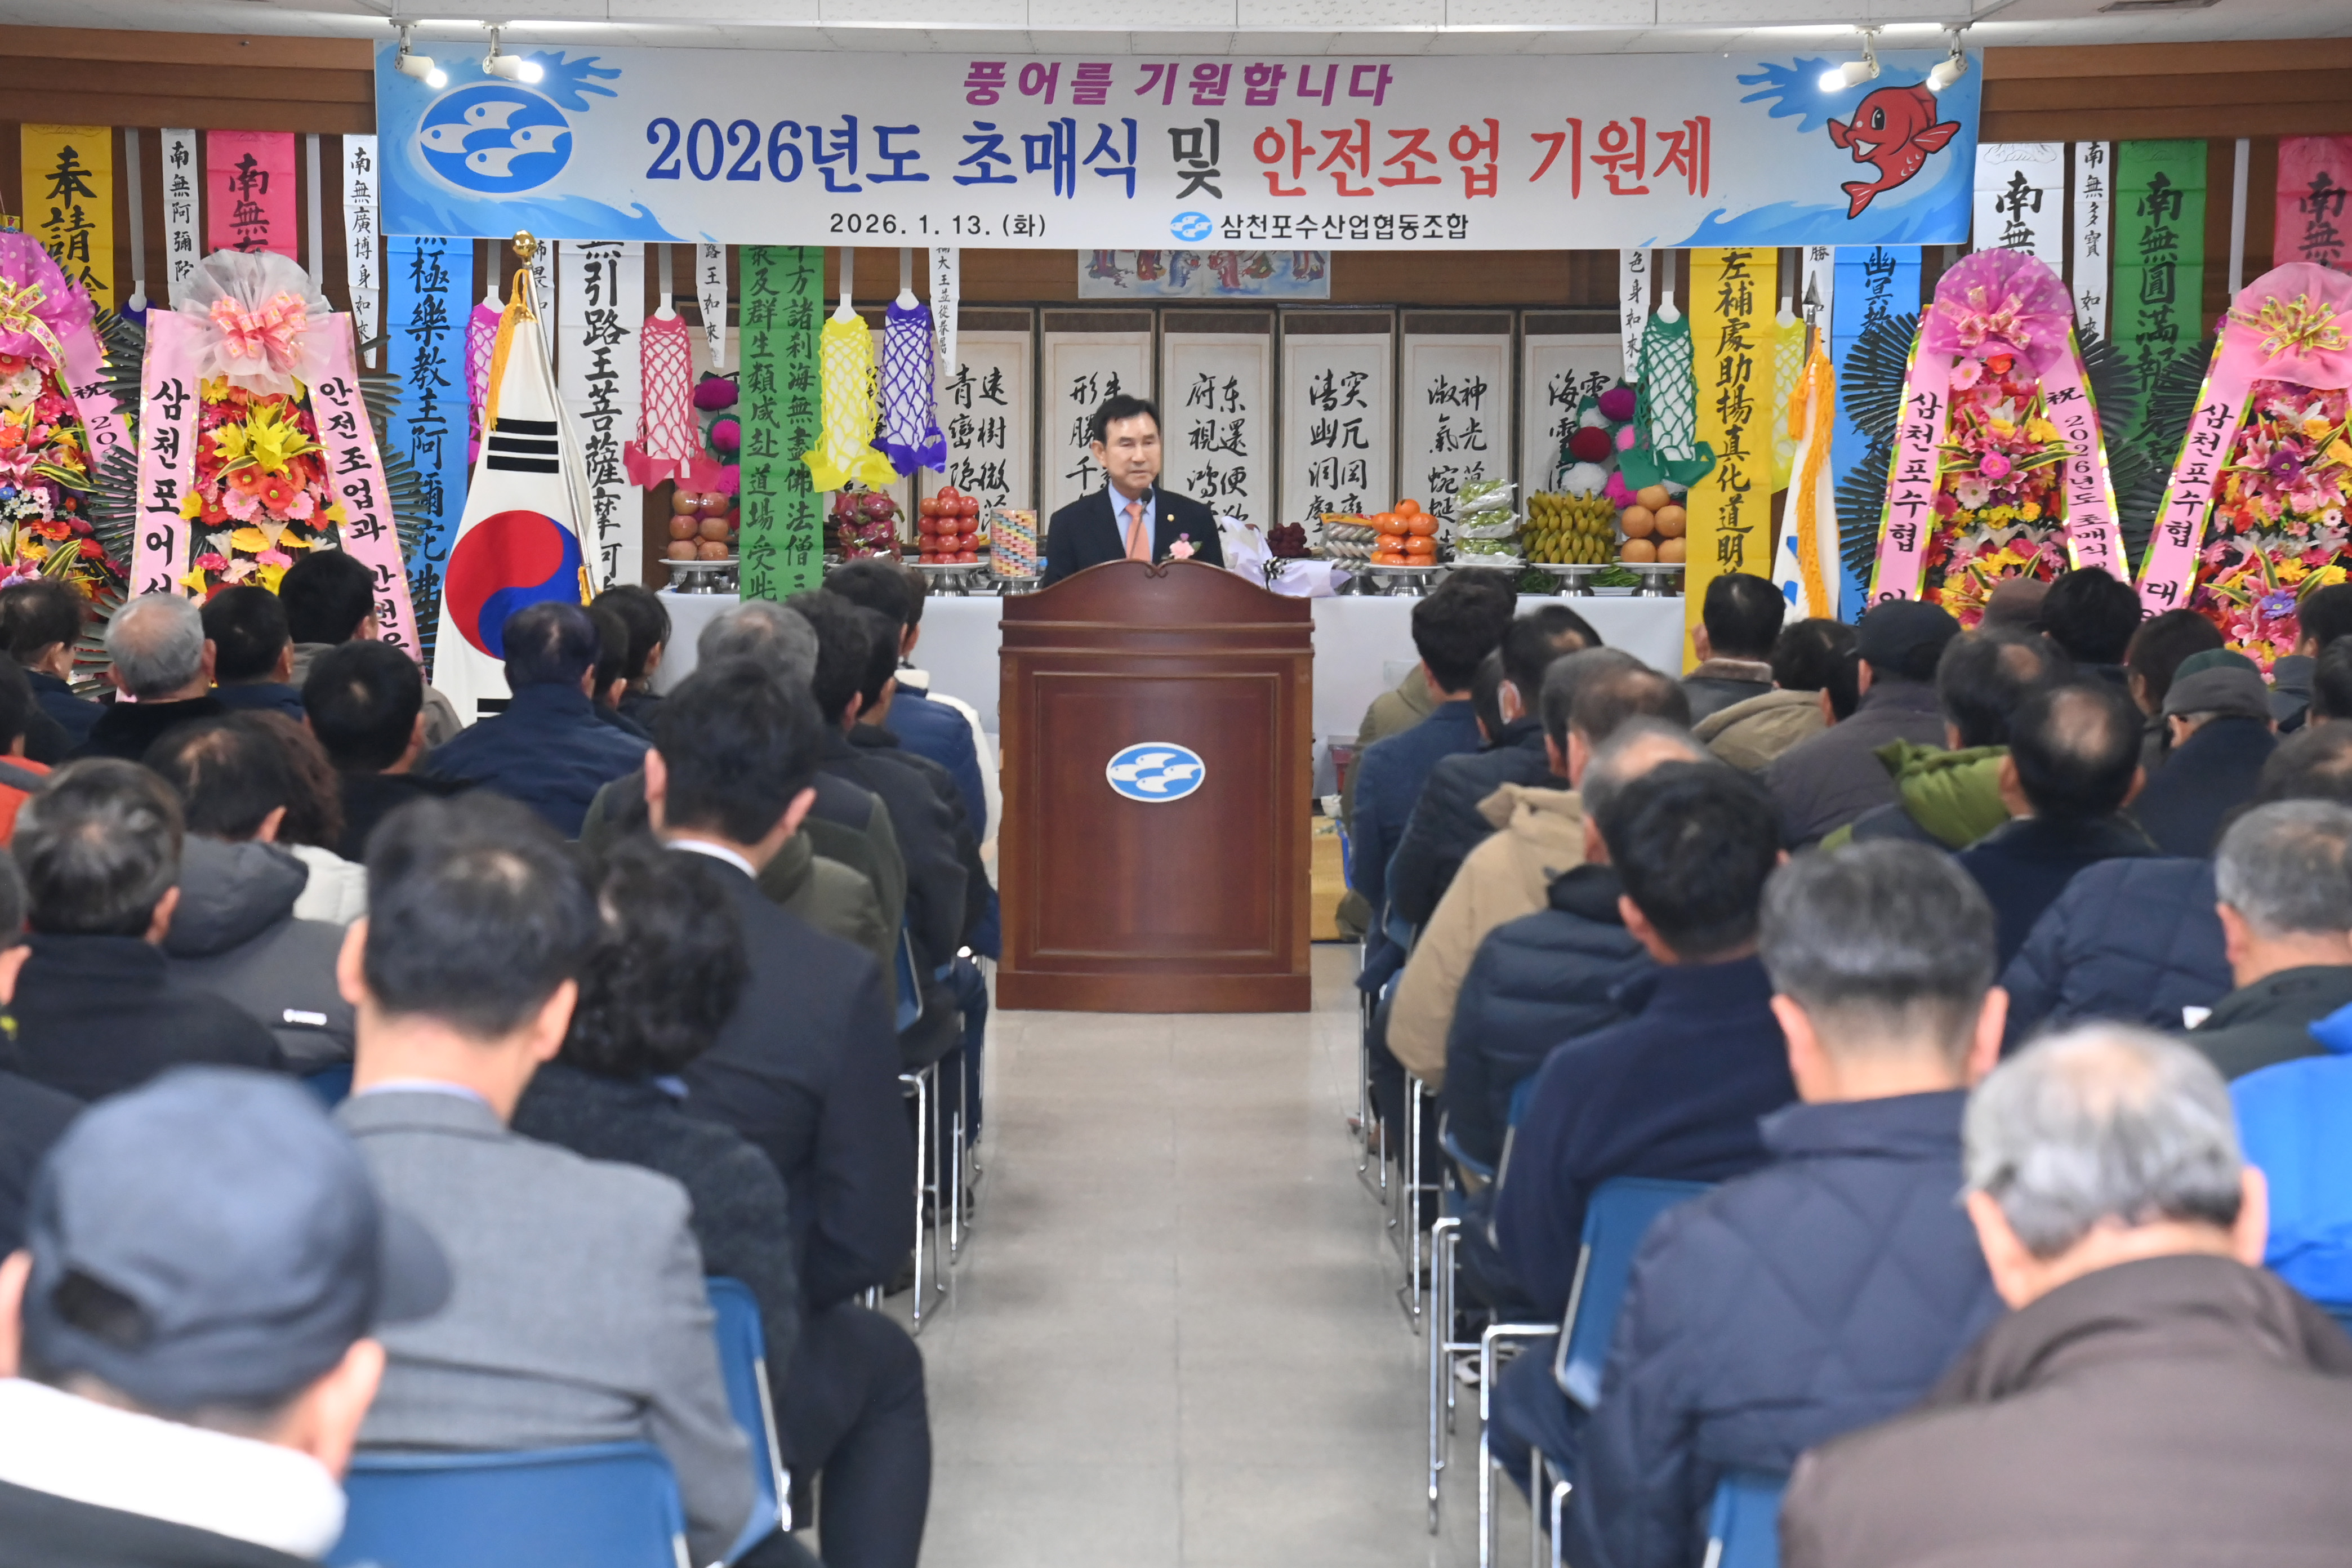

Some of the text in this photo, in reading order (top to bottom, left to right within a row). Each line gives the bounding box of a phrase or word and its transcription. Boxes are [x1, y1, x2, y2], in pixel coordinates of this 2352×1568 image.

[964, 61, 1393, 106] 풍어를 기원합니다
[646, 114, 1711, 199] 2026년도 초매식 및 안전조업 기원제
[830, 213, 906, 234] 2026.
[1003, 214, 1045, 237] (화)
[1220, 213, 1469, 240] 삼천포수산업협동조합
[2047, 387, 2085, 405] 祝
[319, 378, 387, 543] 안전조업과
[1888, 392, 1943, 553] 삼천포수협
[2065, 415, 2104, 506] 2026년도
[2164, 403, 2234, 549] 삼천포수협
